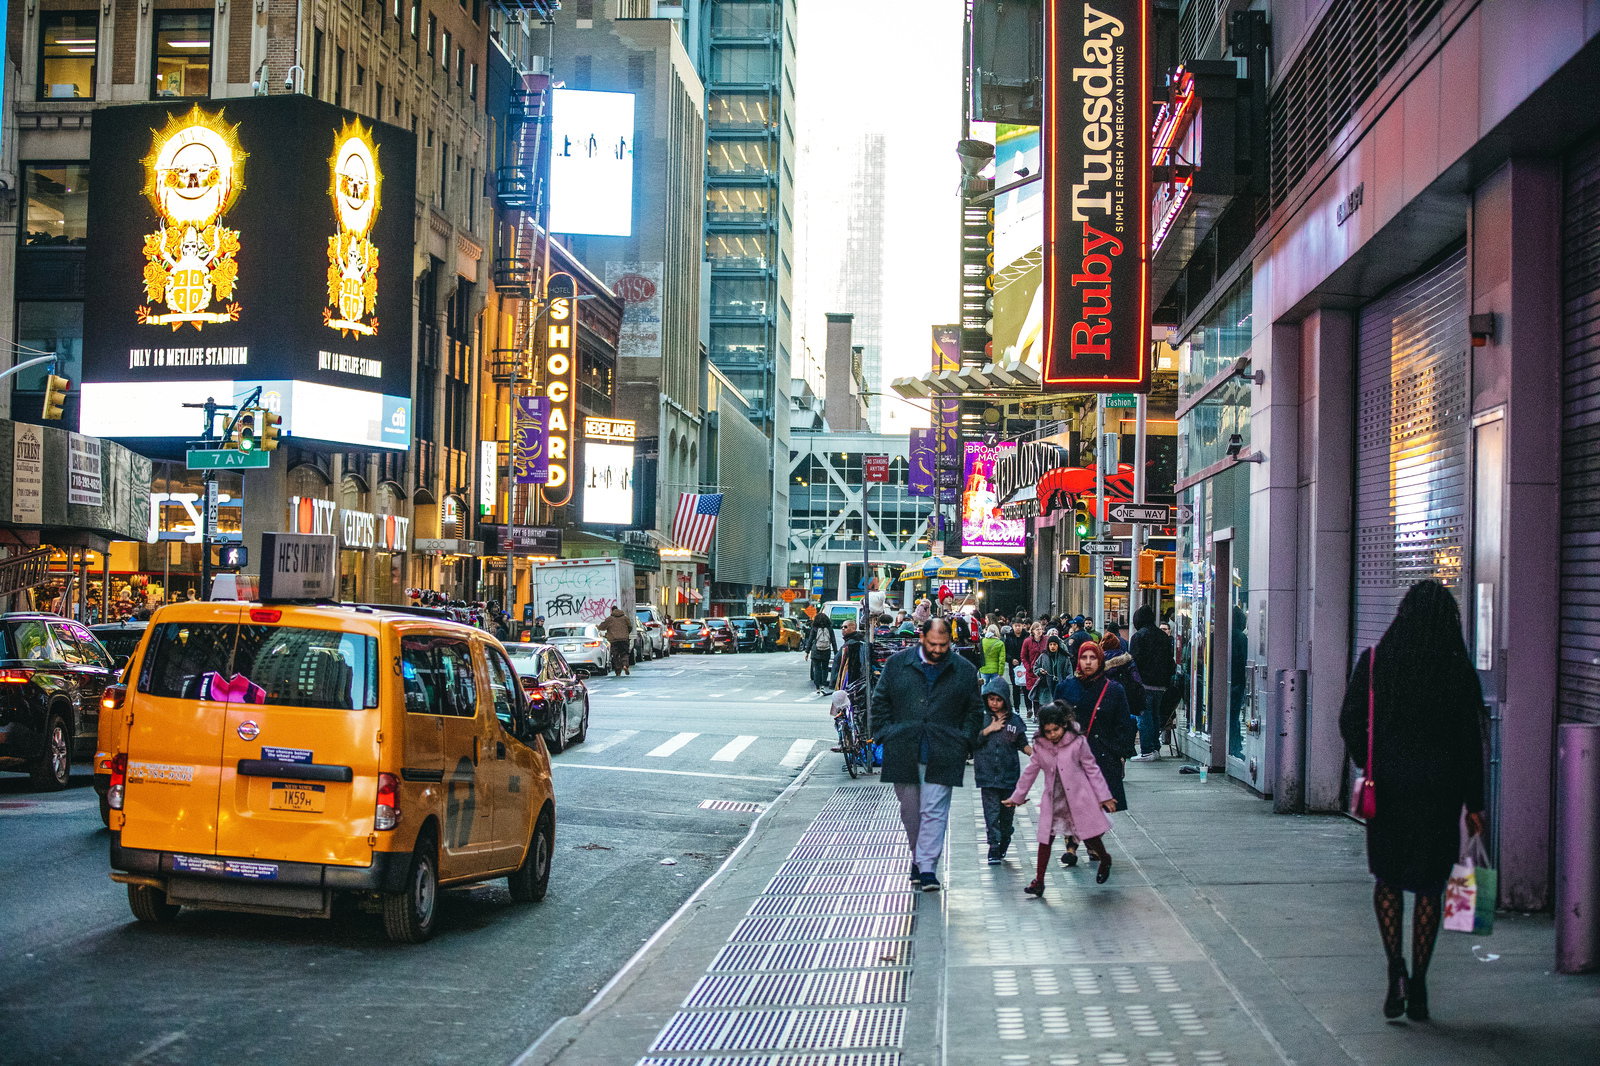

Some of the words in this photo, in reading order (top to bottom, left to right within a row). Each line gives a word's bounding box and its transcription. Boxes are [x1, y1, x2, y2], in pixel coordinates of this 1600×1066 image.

[1115, 45, 1124, 85] DINING
[1072, 3, 1125, 221] Tuesday
[1115, 88, 1124, 149] AMERICAN
[1115, 151, 1124, 188] FRESH
[1115, 190, 1124, 232] SIMPLE
[549, 286, 571, 294] HOTEL
[617, 278, 653, 299] NYSC
[1071, 222, 1124, 360] Ruby
[941, 336, 957, 344] Disney
[129, 349, 151, 369] JULY
[153, 348, 165, 367] 18
[166, 347, 204, 367] METLIFE
[205, 346, 248, 366] STADIUM
[318, 350, 332, 370] JULY
[339, 354, 360, 375] METLIFE
[1107, 397, 1131, 408] Fashion
[585, 420, 635, 437] NEDERLANDER
[17, 441, 40, 460] EVEREST
[211, 454, 220, 465] 7
[225, 454, 245, 465] Av
[995, 452, 1013, 503] RED
[1116, 509, 1135, 518] ONE
[1144, 509, 1165, 519] WAY
[344, 509, 375, 548] GIFTS
[427, 541, 446, 549] 200
[278, 542, 299, 573] HE'S
[300, 543, 310, 573] IN
[310, 543, 326, 573] THIS
